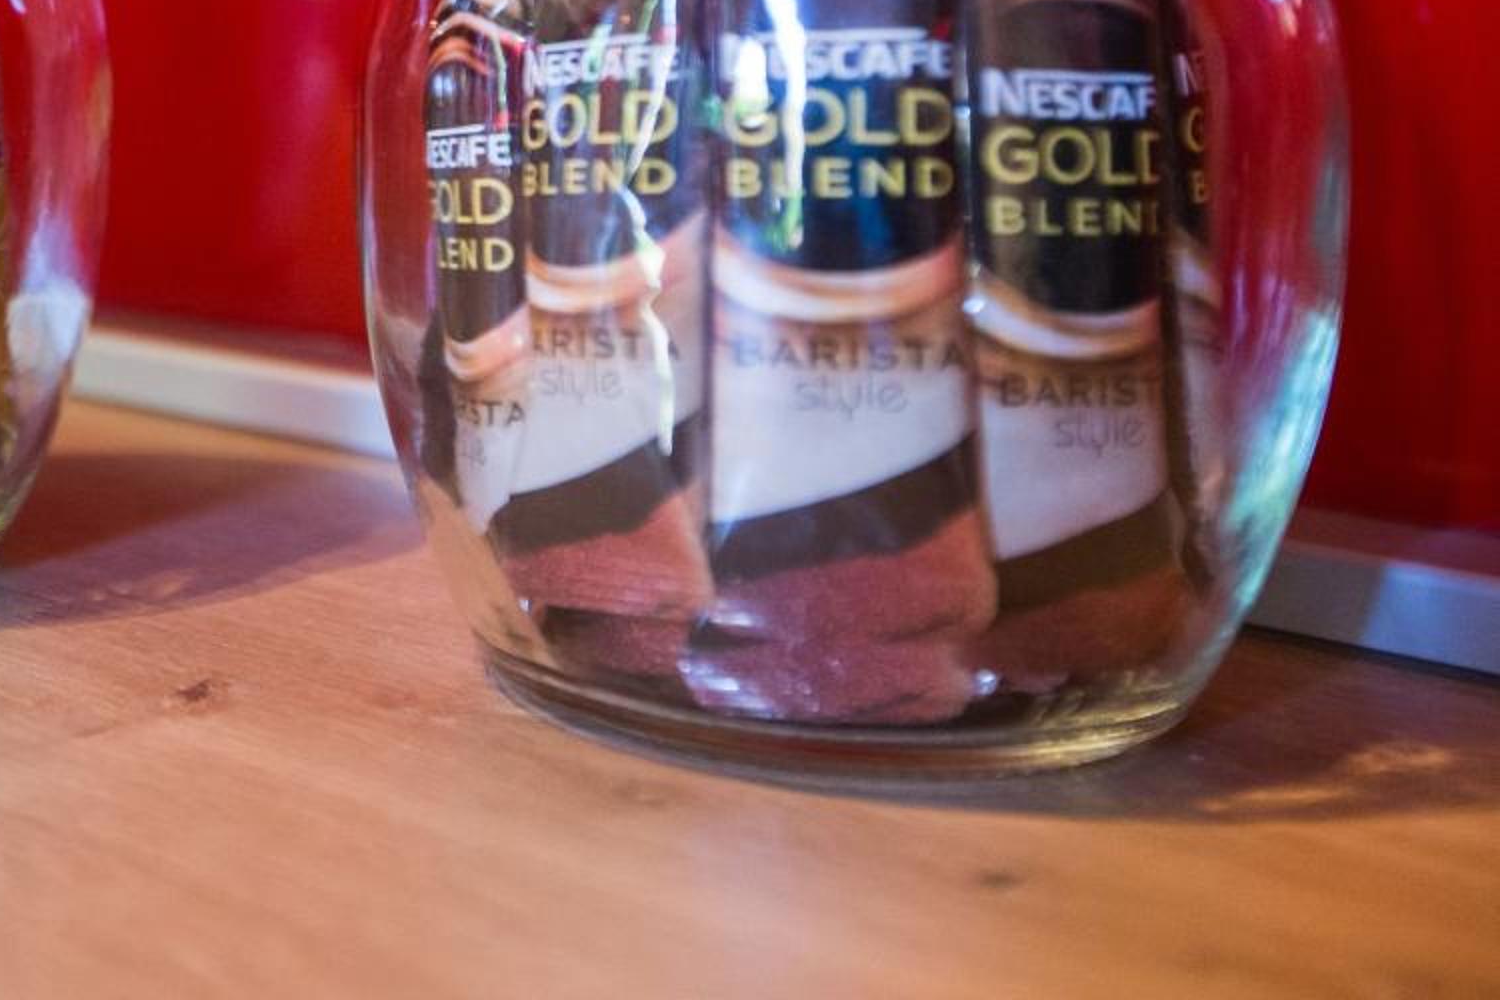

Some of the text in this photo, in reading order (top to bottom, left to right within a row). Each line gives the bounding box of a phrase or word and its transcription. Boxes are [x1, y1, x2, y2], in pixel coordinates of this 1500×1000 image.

[980, 67, 1157, 121] NESCAF
[521, 87, 678, 150] GOLD
[724, 86, 952, 147] GOLD
[521, 157, 677, 198] BLEND
[725, 155, 955, 199] BLEND
[430, 176, 514, 225] OLD
[987, 195, 1158, 236] BLEN
[436, 236, 515, 272] LEND
[532, 327, 679, 361] ARIST
[541, 364, 623, 405] style
[794, 376, 908, 421] style
[1000, 372, 1150, 408] BARIS
[1054, 410, 1147, 458] style
